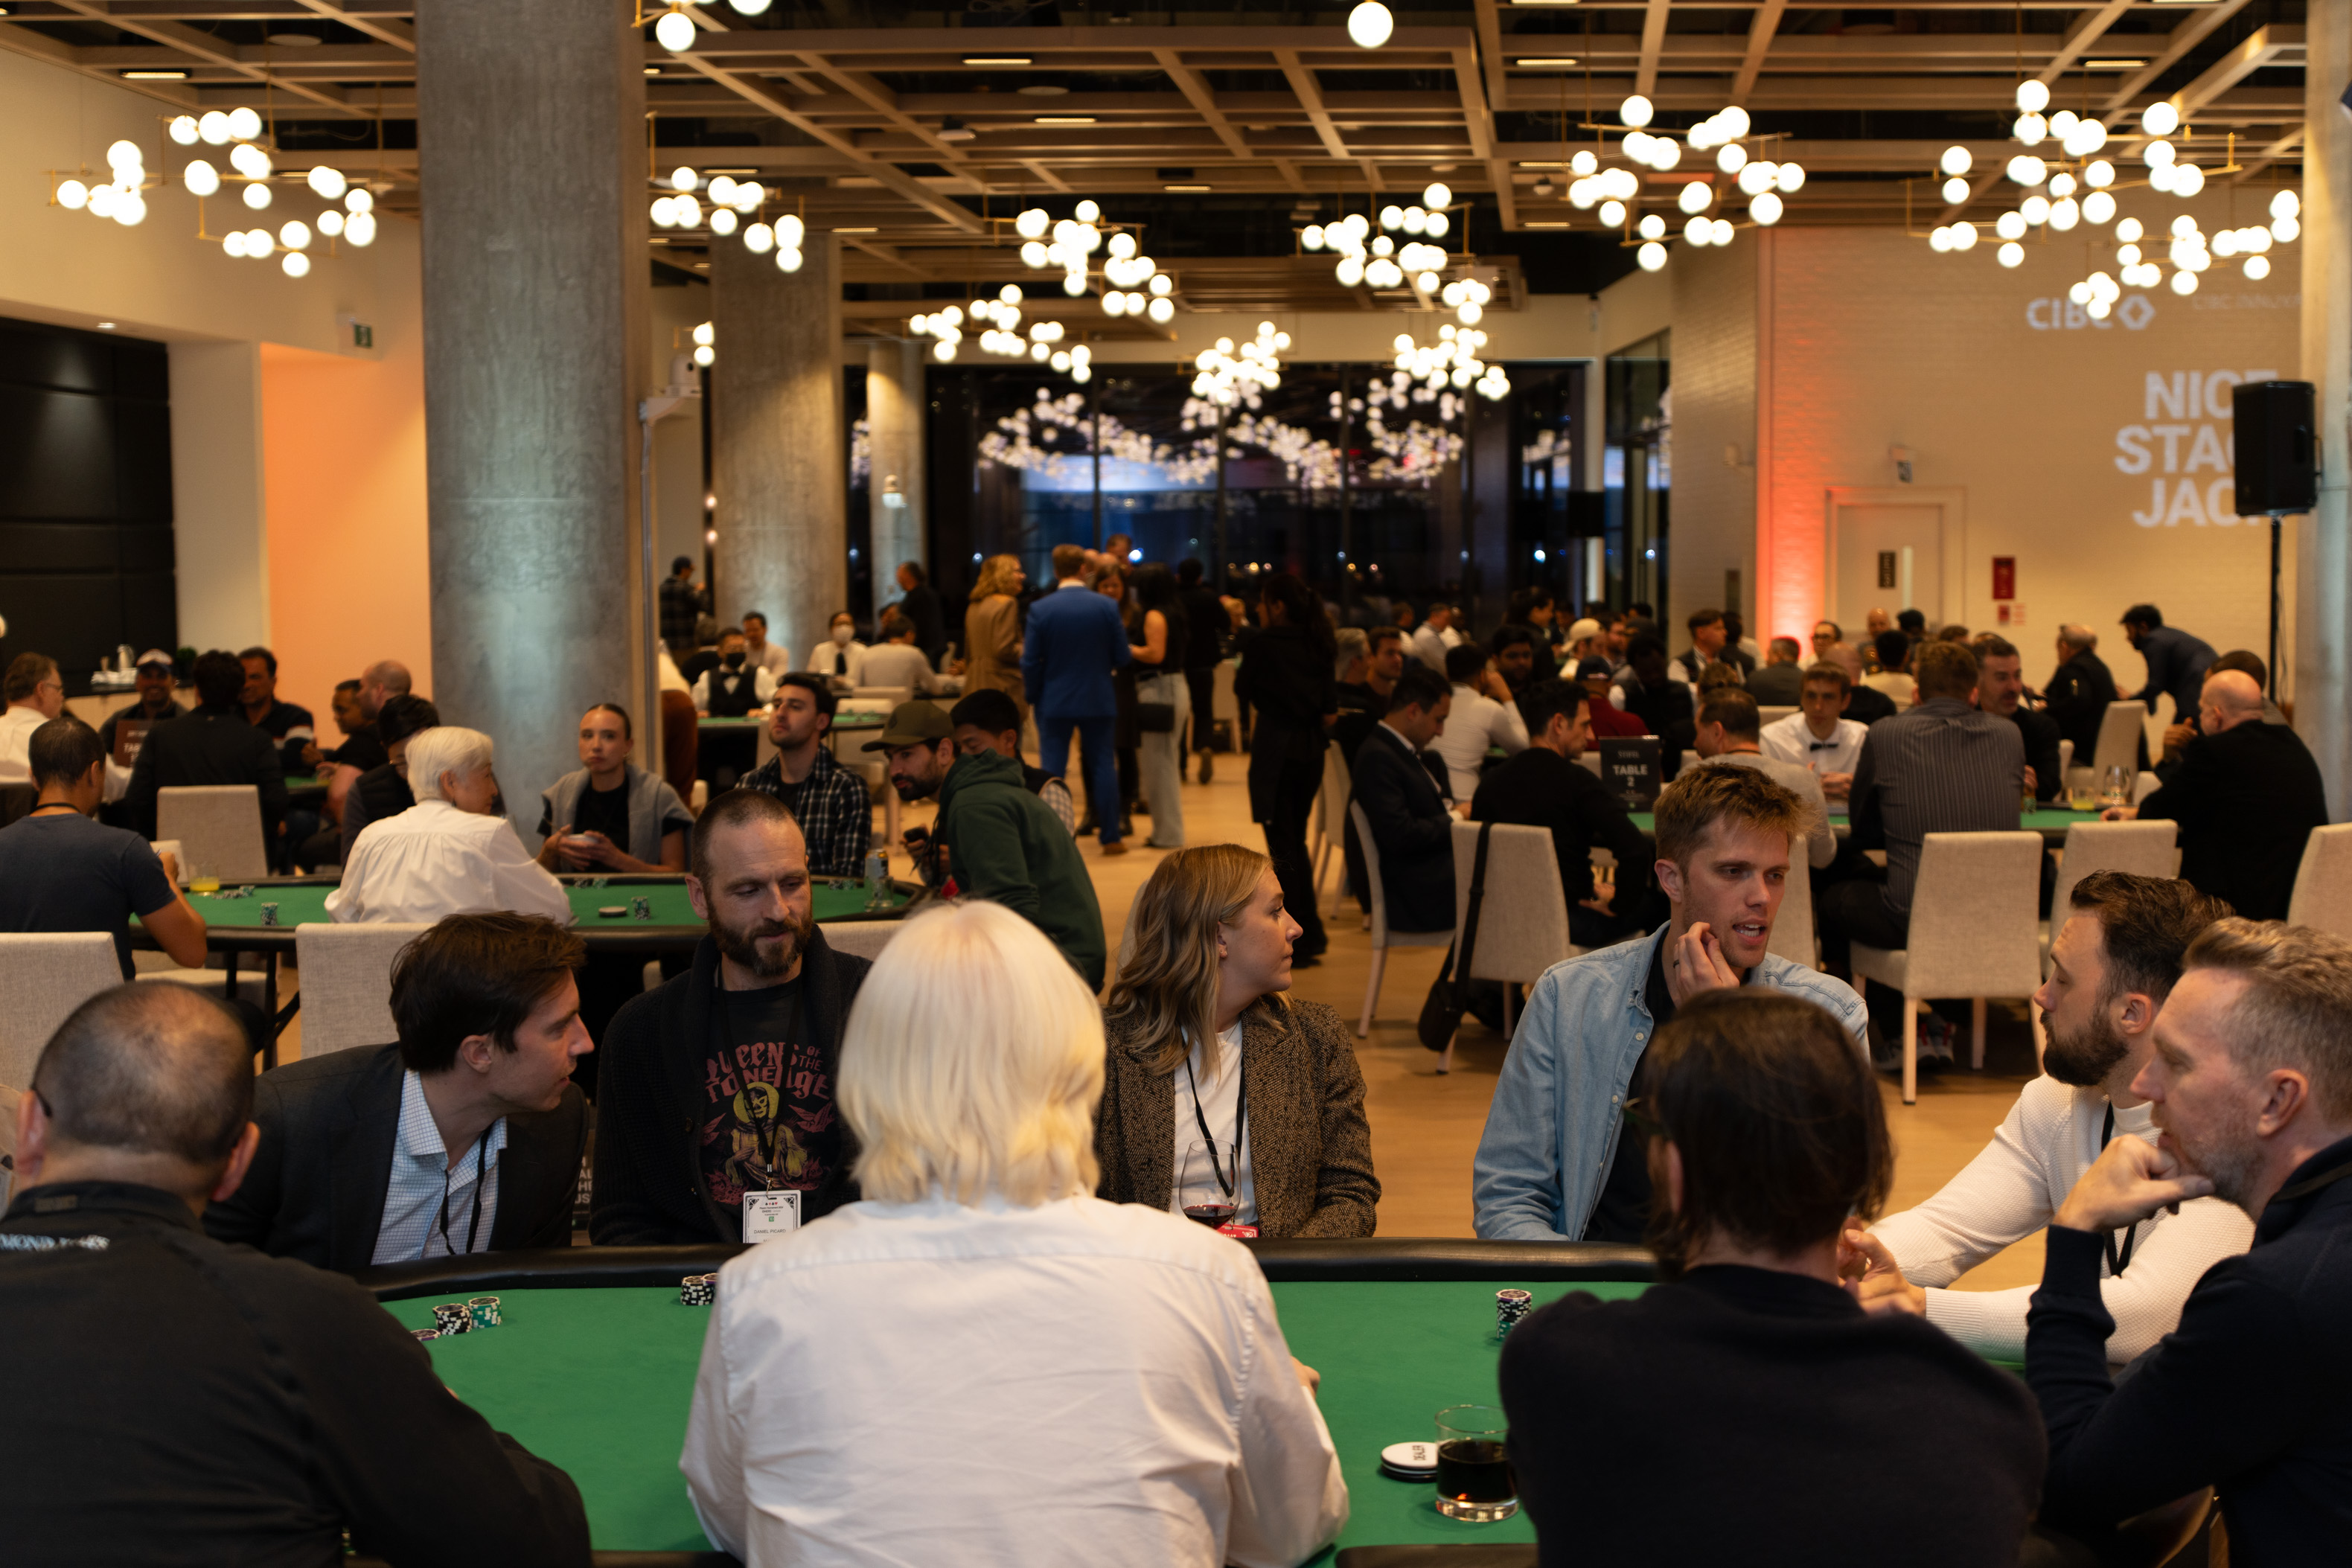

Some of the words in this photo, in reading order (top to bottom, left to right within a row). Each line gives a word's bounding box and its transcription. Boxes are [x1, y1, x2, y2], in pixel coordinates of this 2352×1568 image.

[2144, 369, 2278, 420] NIC
[2115, 424, 2235, 474] STA
[2132, 477, 2260, 528] JAC
[1612, 764, 1648, 775] TABLE
[1626, 775, 1635, 787] 2
[799, 1055, 824, 1072] THE
